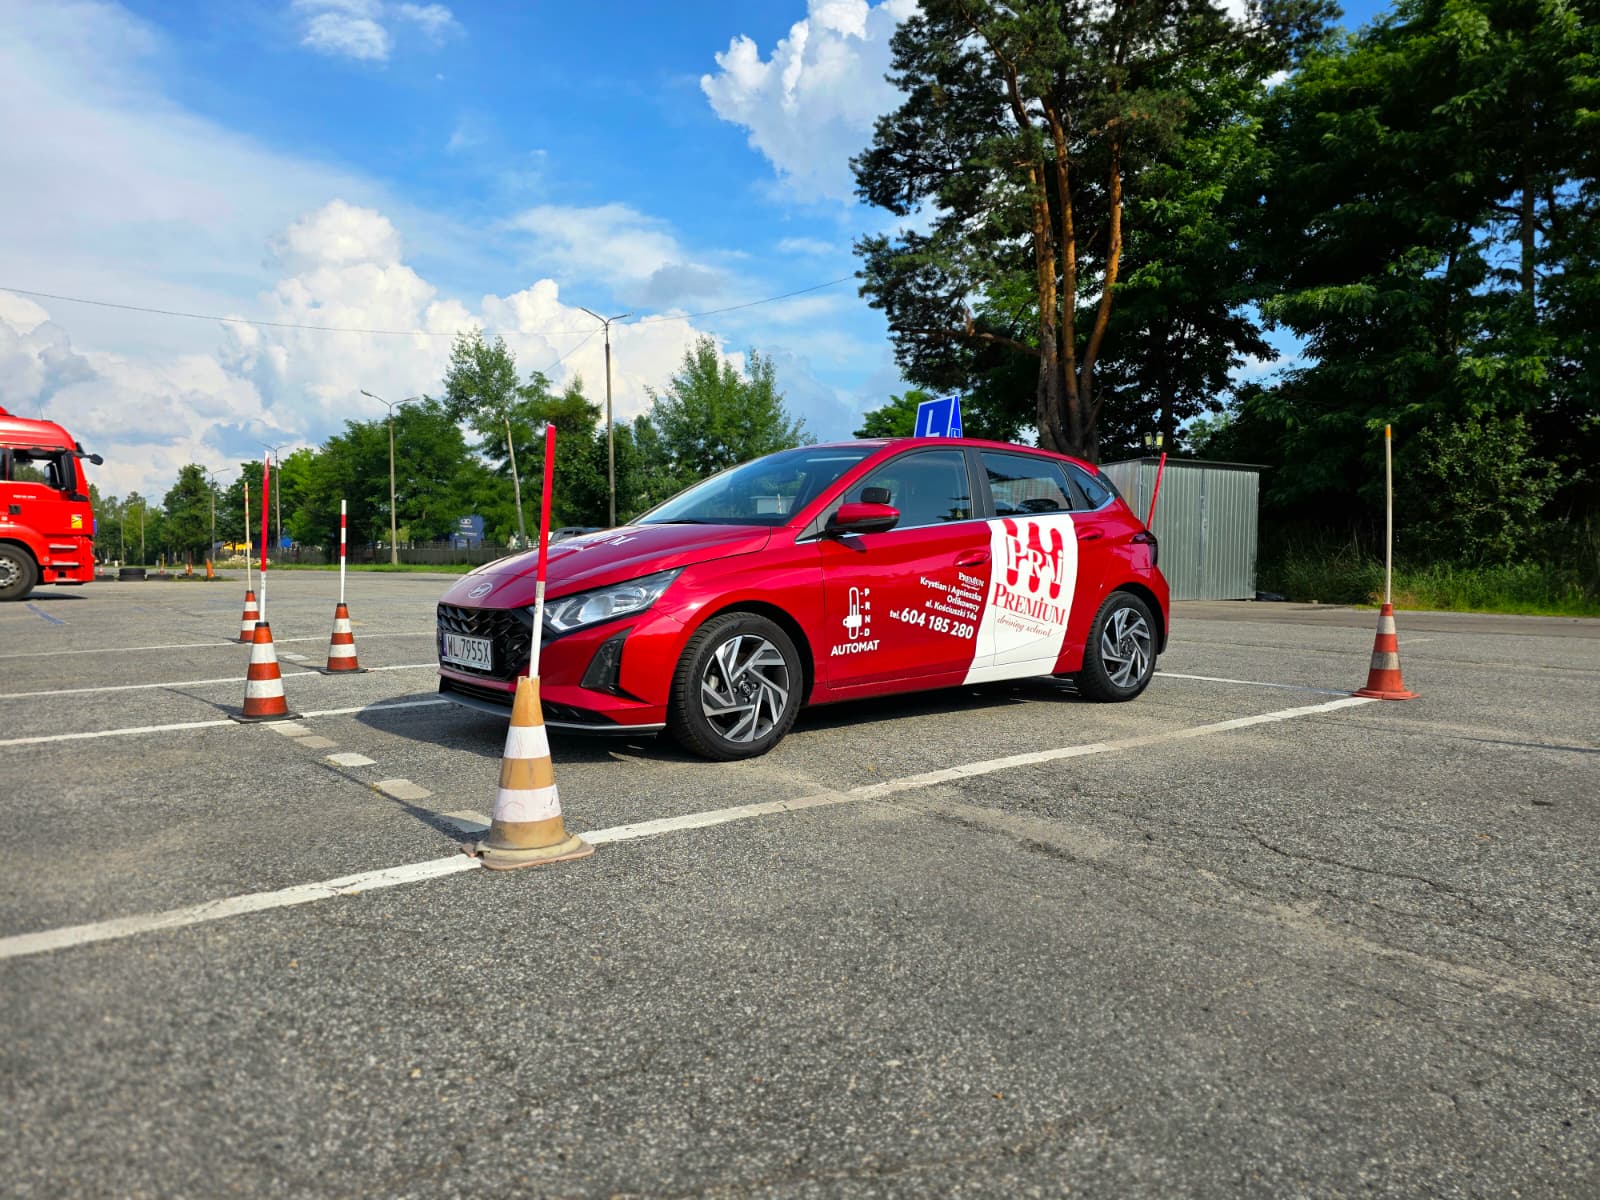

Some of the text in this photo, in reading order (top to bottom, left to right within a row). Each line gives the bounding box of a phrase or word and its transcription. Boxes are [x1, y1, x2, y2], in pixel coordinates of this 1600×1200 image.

[925, 409, 940, 438] L
[864, 587, 870, 597] P
[920, 576, 947, 591] Krystian
[951, 586, 982, 602] Agnieszka
[864, 614, 871, 623] N
[901, 607, 926, 627] 604
[928, 615, 951, 633] 185
[950, 621, 974, 639] 280
[864, 628, 870, 637] D
[830, 640, 880, 657] AUTOMAT
